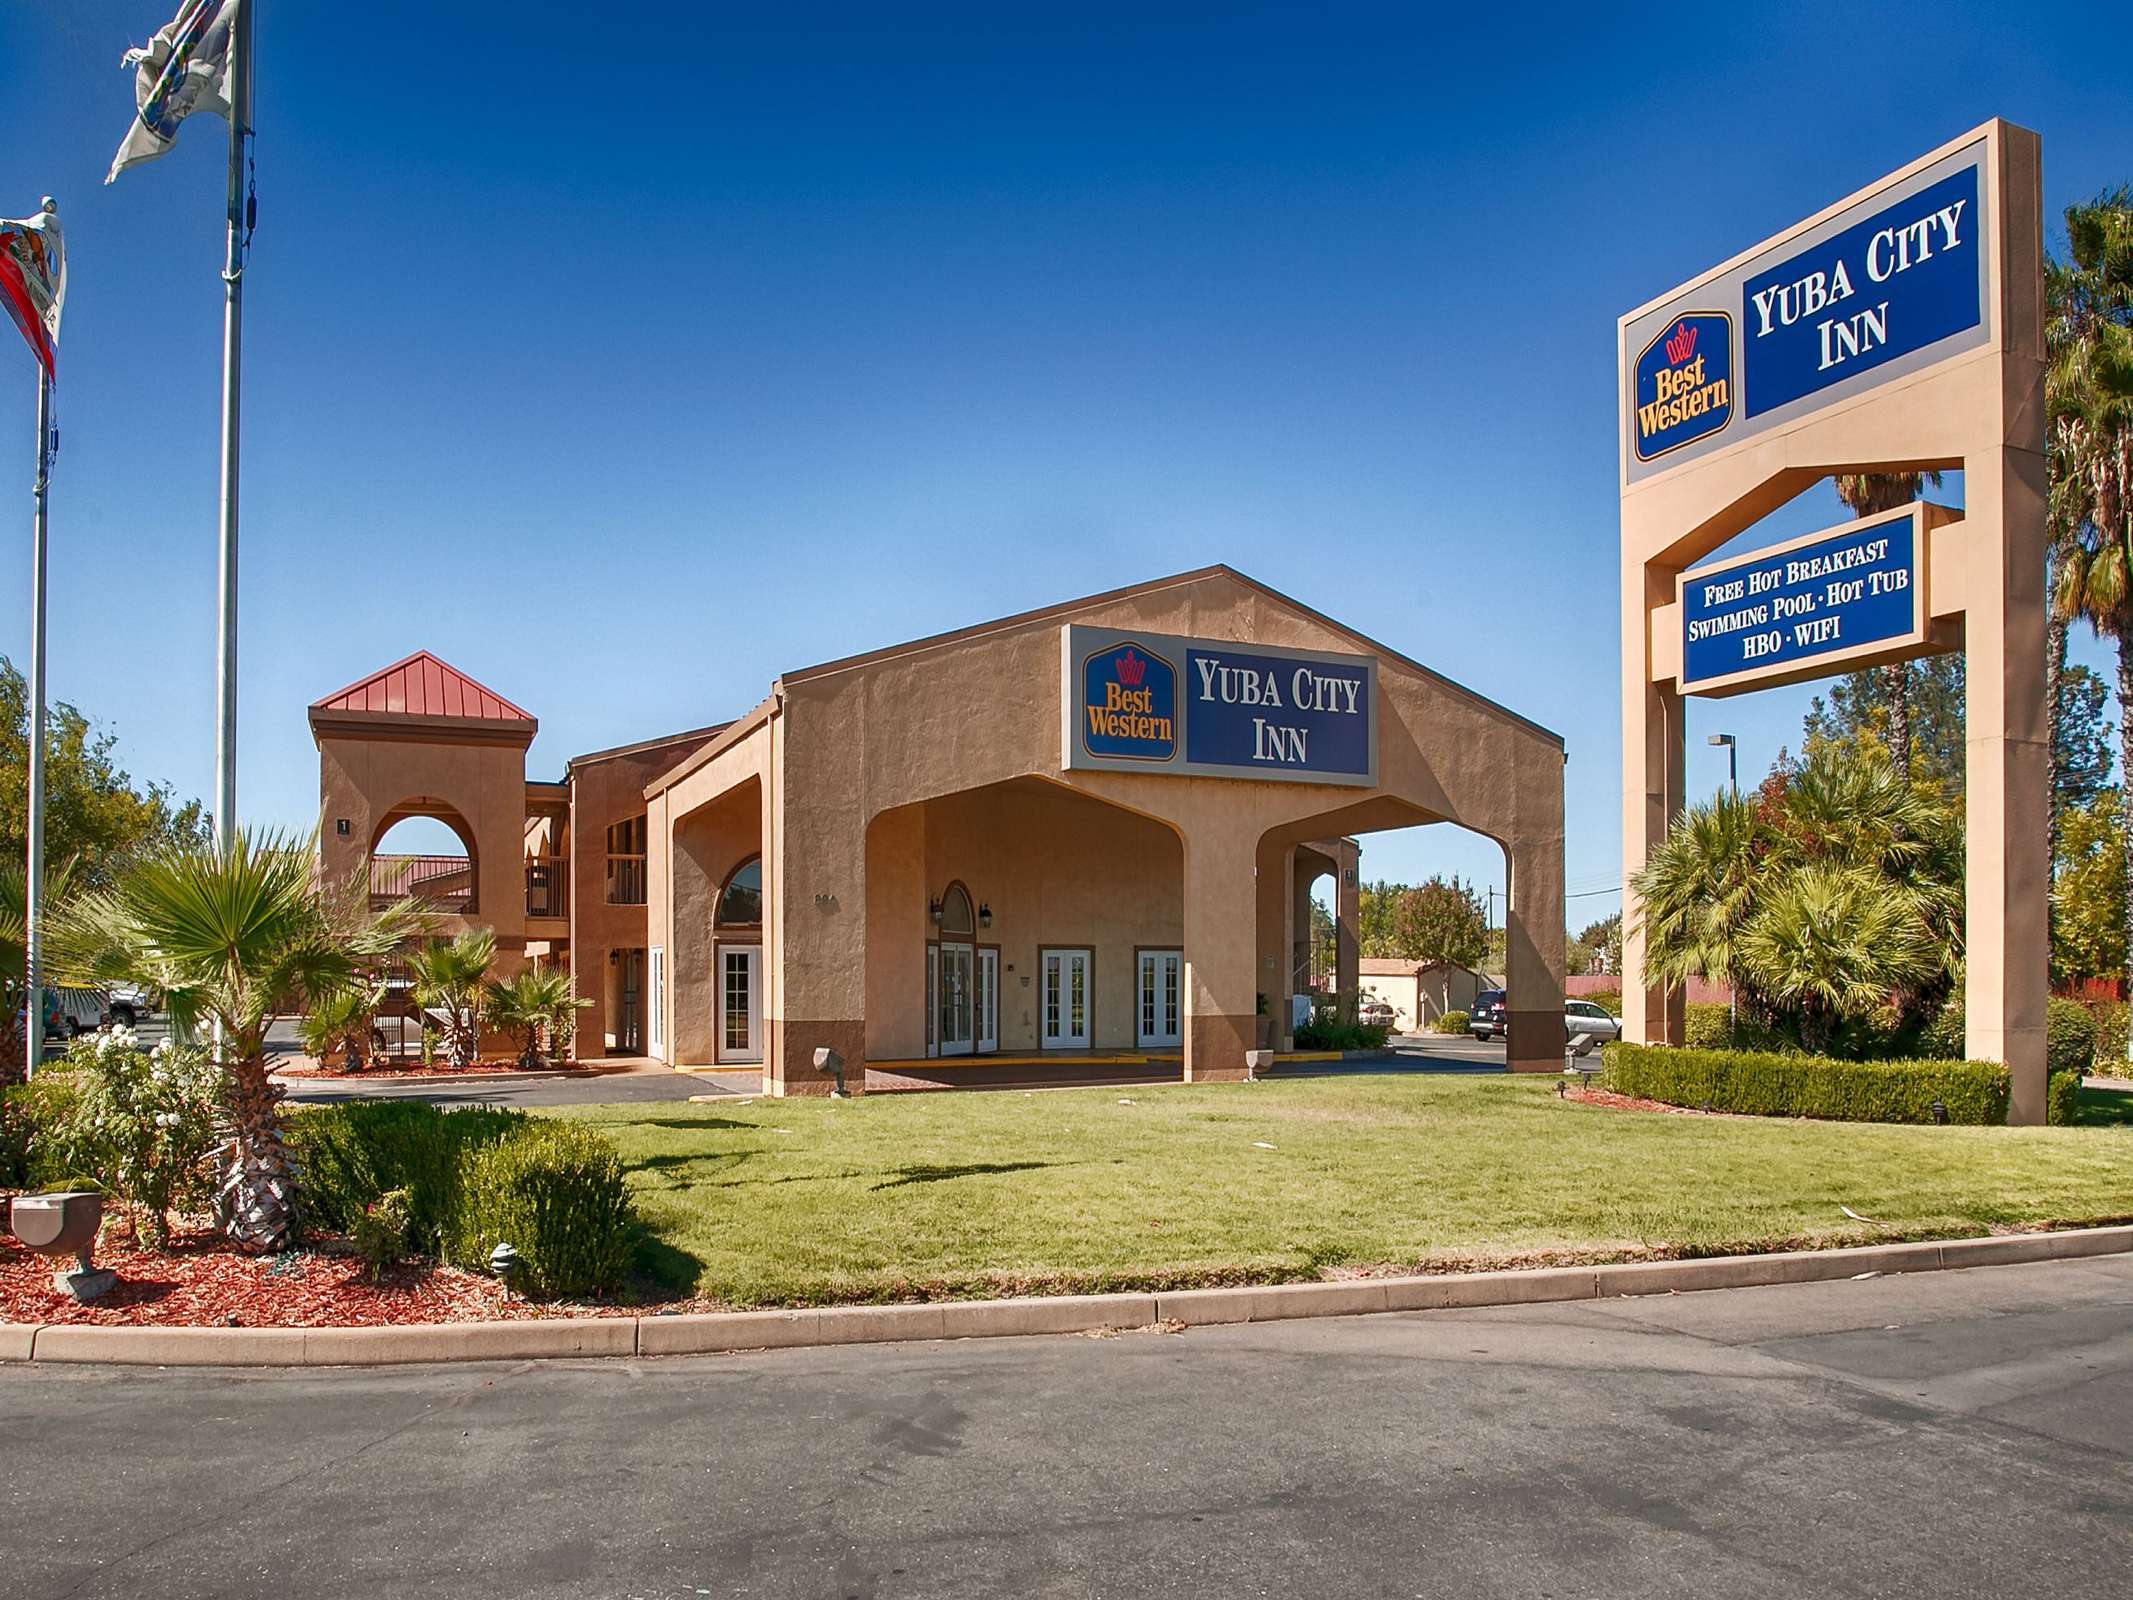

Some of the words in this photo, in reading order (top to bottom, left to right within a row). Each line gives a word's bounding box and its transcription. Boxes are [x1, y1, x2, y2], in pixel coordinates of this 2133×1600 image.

[1752, 259, 1854, 337] YUBA
[1866, 200, 1966, 282] CITY
[1817, 301, 1889, 370] INN
[1655, 353, 1705, 402] Best
[1638, 379, 1728, 438] Western
[1704, 580, 1744, 607] FREE
[1748, 569, 1782, 595] HOT
[1786, 538, 1888, 585] BREAKFAST
[1688, 604, 1768, 642] SWIMMING
[1773, 593, 1816, 620] POOL
[1826, 579, 1863, 607] HOT
[1868, 568, 1909, 596] TUB
[1743, 631, 1782, 659] HBO
[1794, 616, 1841, 647] WIFI
[1105, 681, 1152, 713] Best
[1194, 658, 1283, 707] YUBA
[1292, 668, 1361, 713] CITY
[1087, 705, 1173, 740] Western
[1252, 718, 1308, 763] INN
